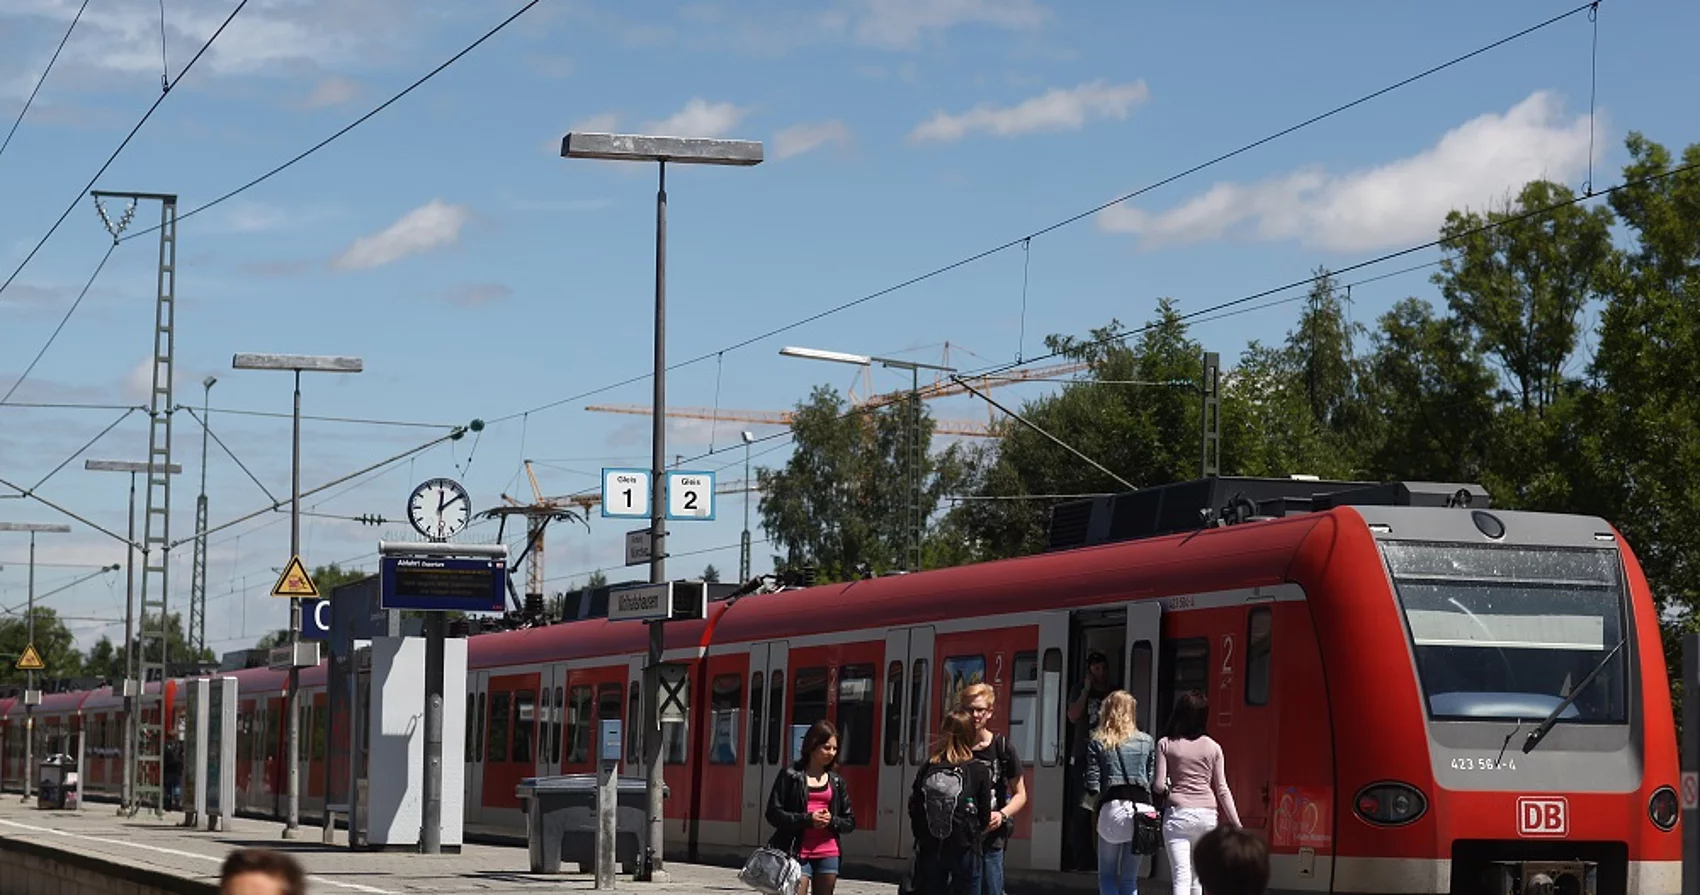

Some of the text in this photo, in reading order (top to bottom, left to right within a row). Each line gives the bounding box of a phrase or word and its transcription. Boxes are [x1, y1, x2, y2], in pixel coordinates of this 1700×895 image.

[622, 488, 632, 508] 1
[684, 491, 698, 510] 2
[1223, 635, 1234, 673] 2
[995, 654, 1003, 683] 2
[1451, 758, 1474, 770] 423
[1524, 803, 1562, 830] DB
